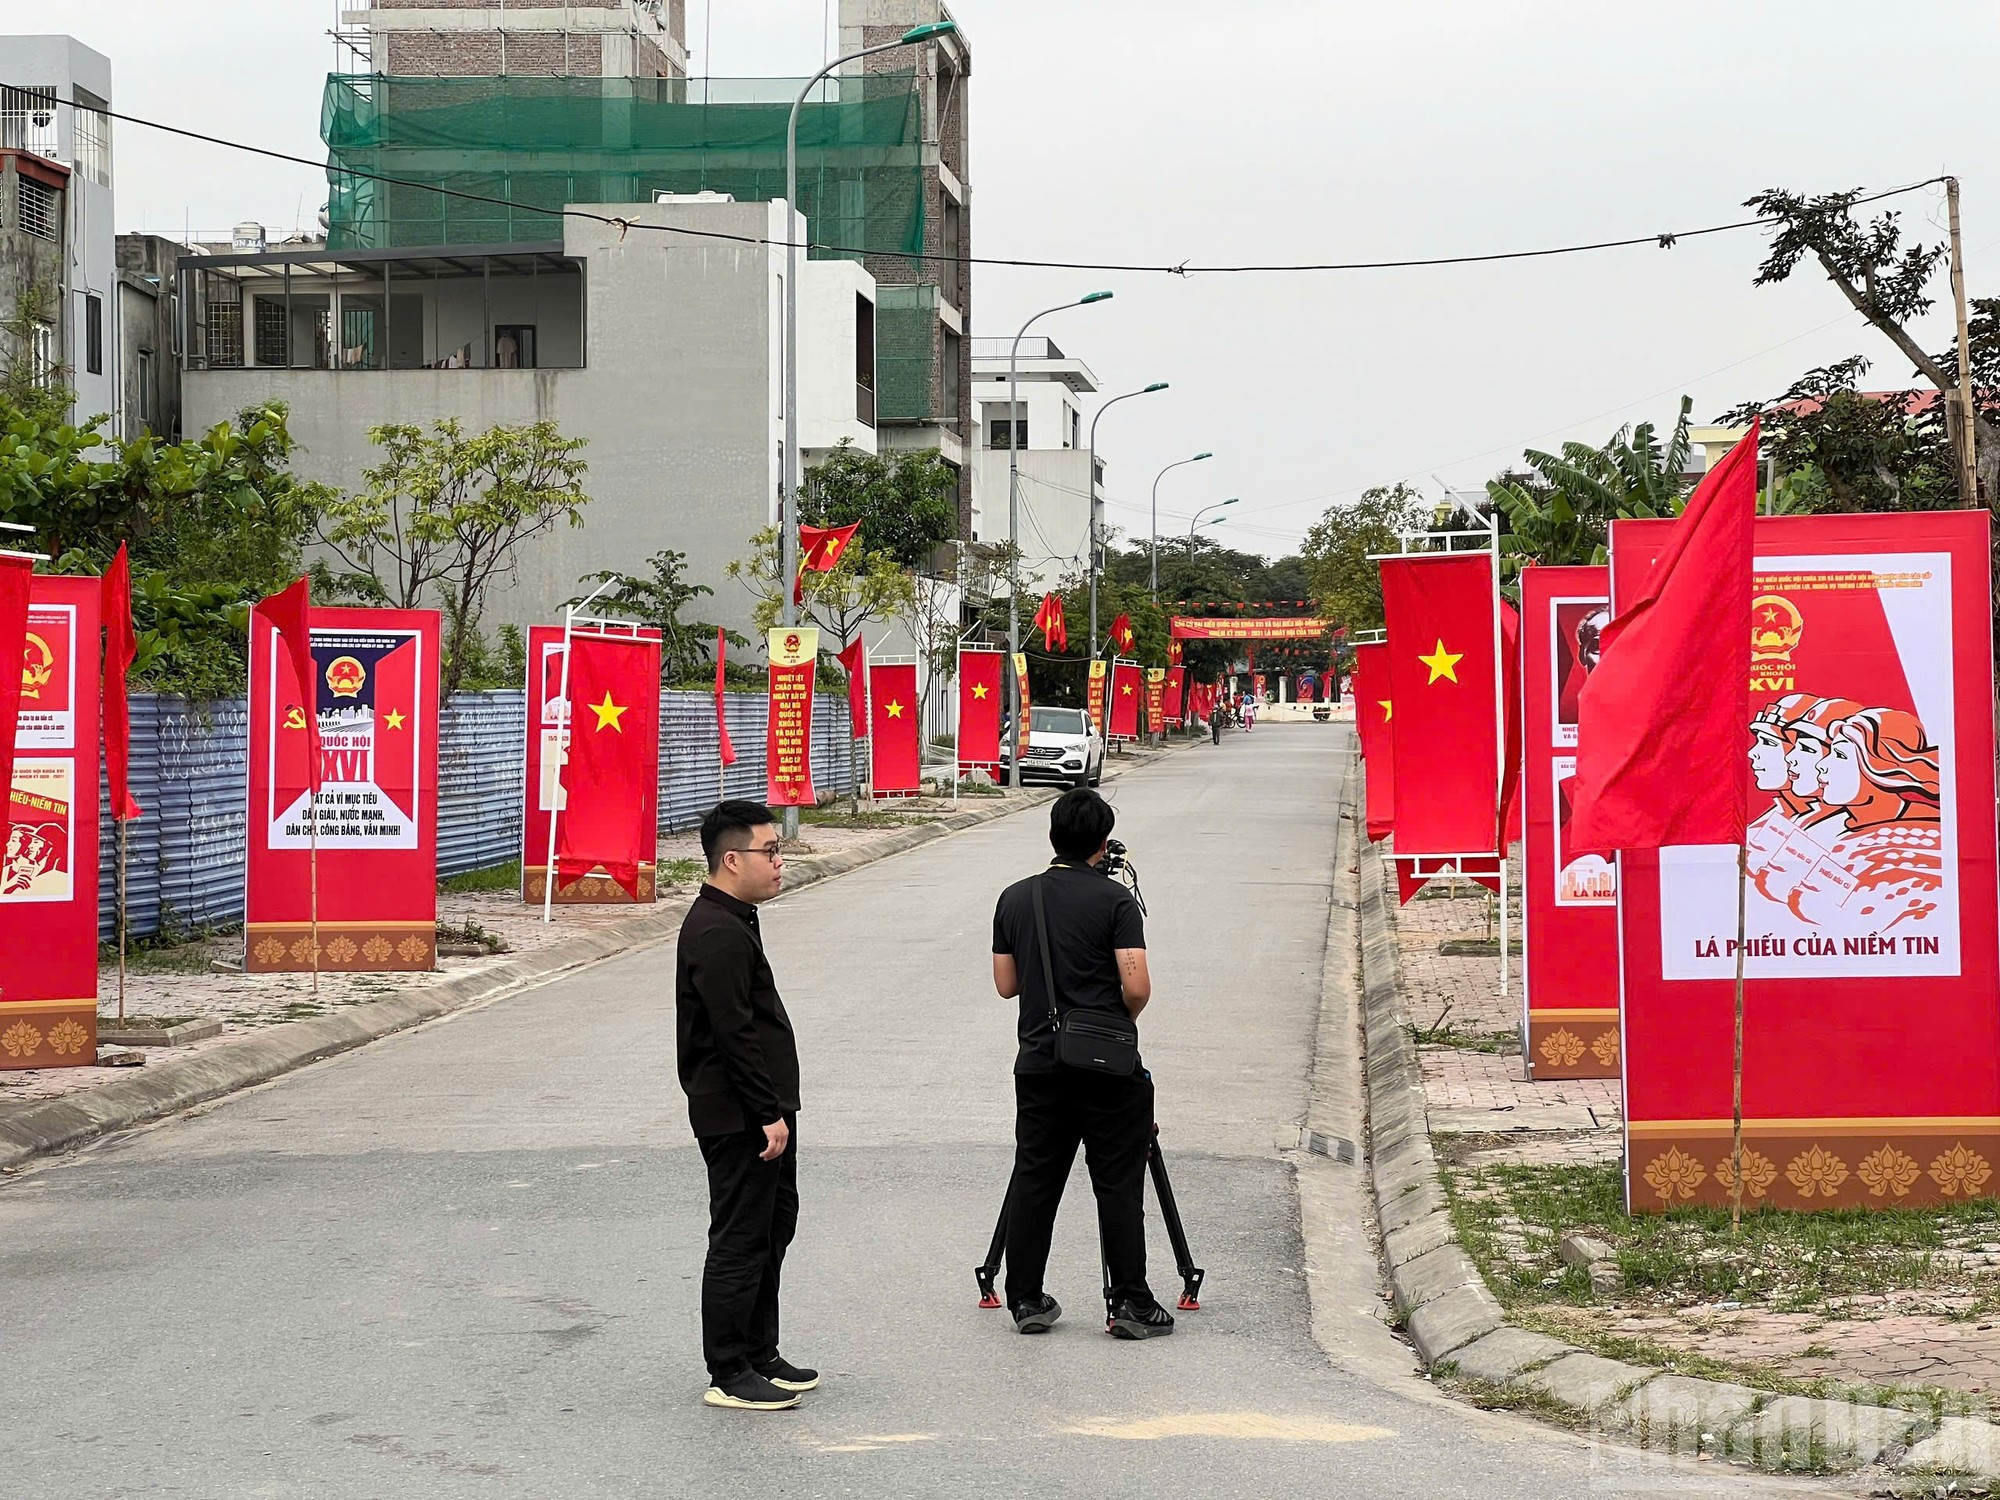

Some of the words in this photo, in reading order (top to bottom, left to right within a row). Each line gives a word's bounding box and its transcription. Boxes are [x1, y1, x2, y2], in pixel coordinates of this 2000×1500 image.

[1750, 677, 1794, 691] XVI
[352, 736, 370, 749] HỘI
[322, 750, 368, 781] XVI
[325, 790, 335, 804] CẢ
[337, 792, 343, 804] VÌ
[345, 794, 360, 806] MỤC
[362, 792, 377, 804] TIÊU
[54, 802, 67, 815] TIN
[320, 807, 338, 821] GIÀU,
[340, 805, 359, 820] NƯỚC
[362, 810, 385, 822] MẠNH,
[286, 823, 300, 835] DÂN
[320, 823, 339, 836] CÔNG
[341, 820, 362, 836] BẰNG,
[364, 823, 378, 835] VĂN
[380, 825, 401, 835] MINH!
[1574, 888, 1589, 897] LÀ
[1695, 935, 1720, 957] LÁ
[1726, 932, 1786, 957] PHIẾU
[1793, 931, 1837, 957] CỦA
[1844, 930, 1896, 956] NIỀM
[1903, 936, 1939, 956] TIN
